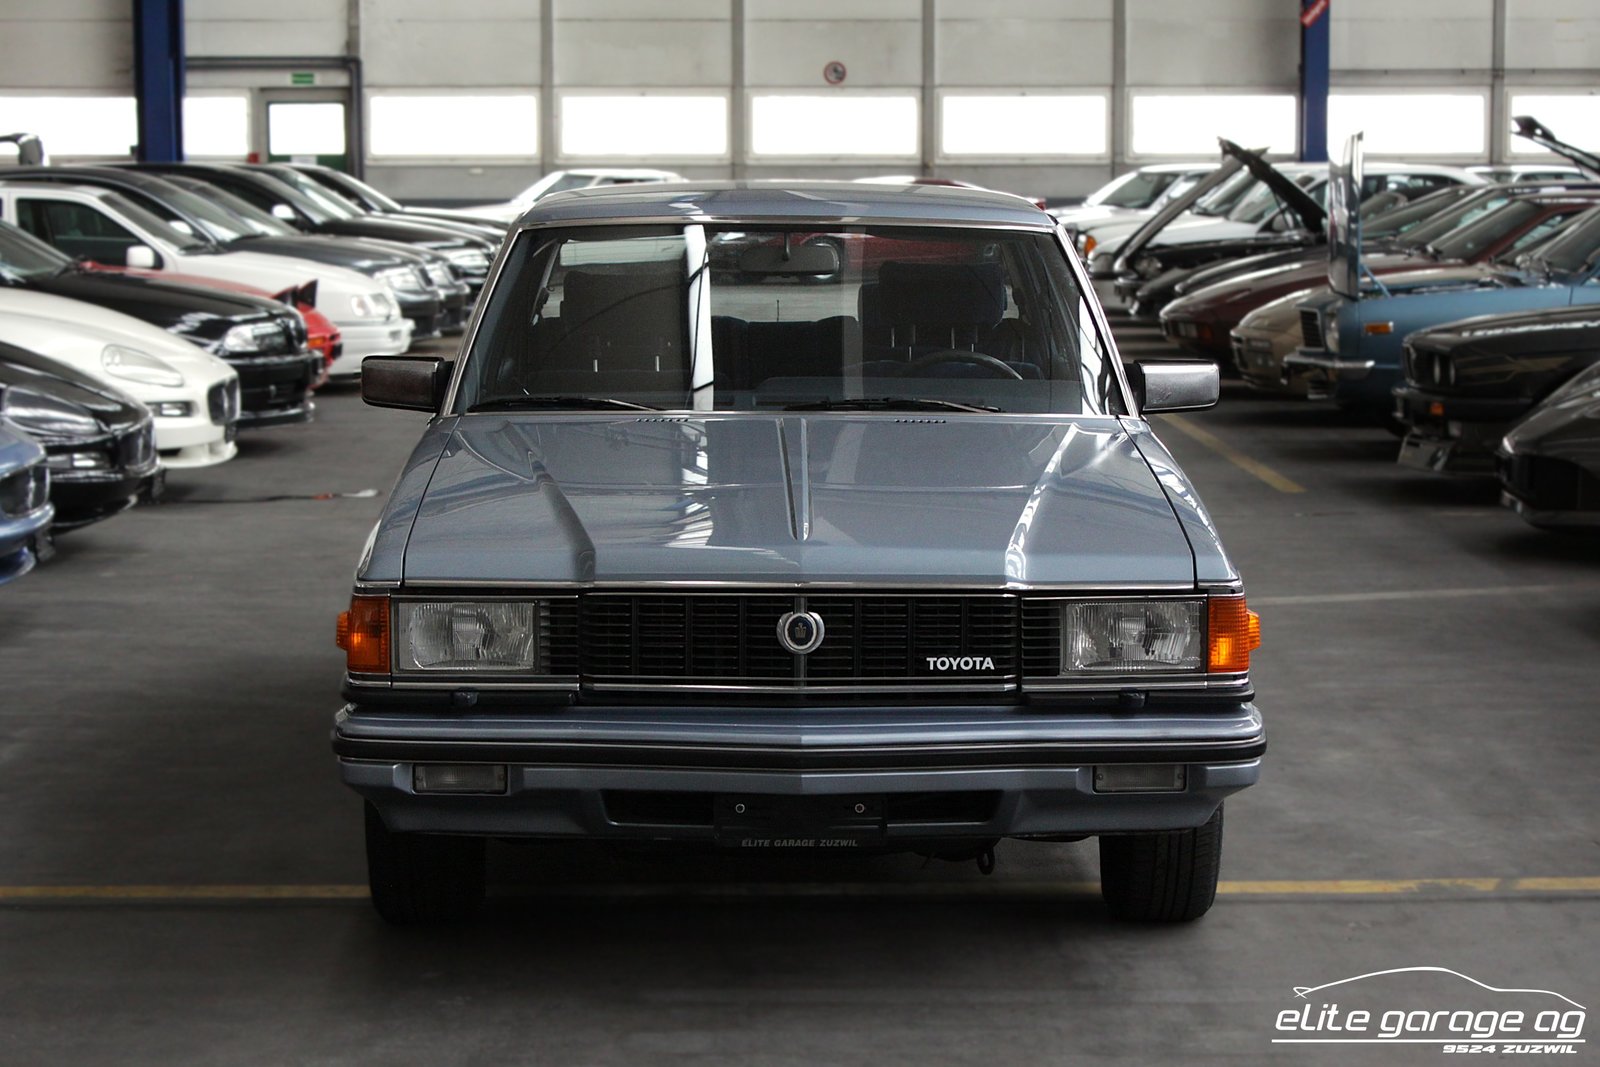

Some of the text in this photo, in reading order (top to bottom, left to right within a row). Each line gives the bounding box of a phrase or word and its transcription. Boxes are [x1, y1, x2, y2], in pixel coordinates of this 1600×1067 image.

[926, 657, 995, 671] TOYOTA
[741, 839, 858, 847] ELITE GARAGE ZUZWIL
